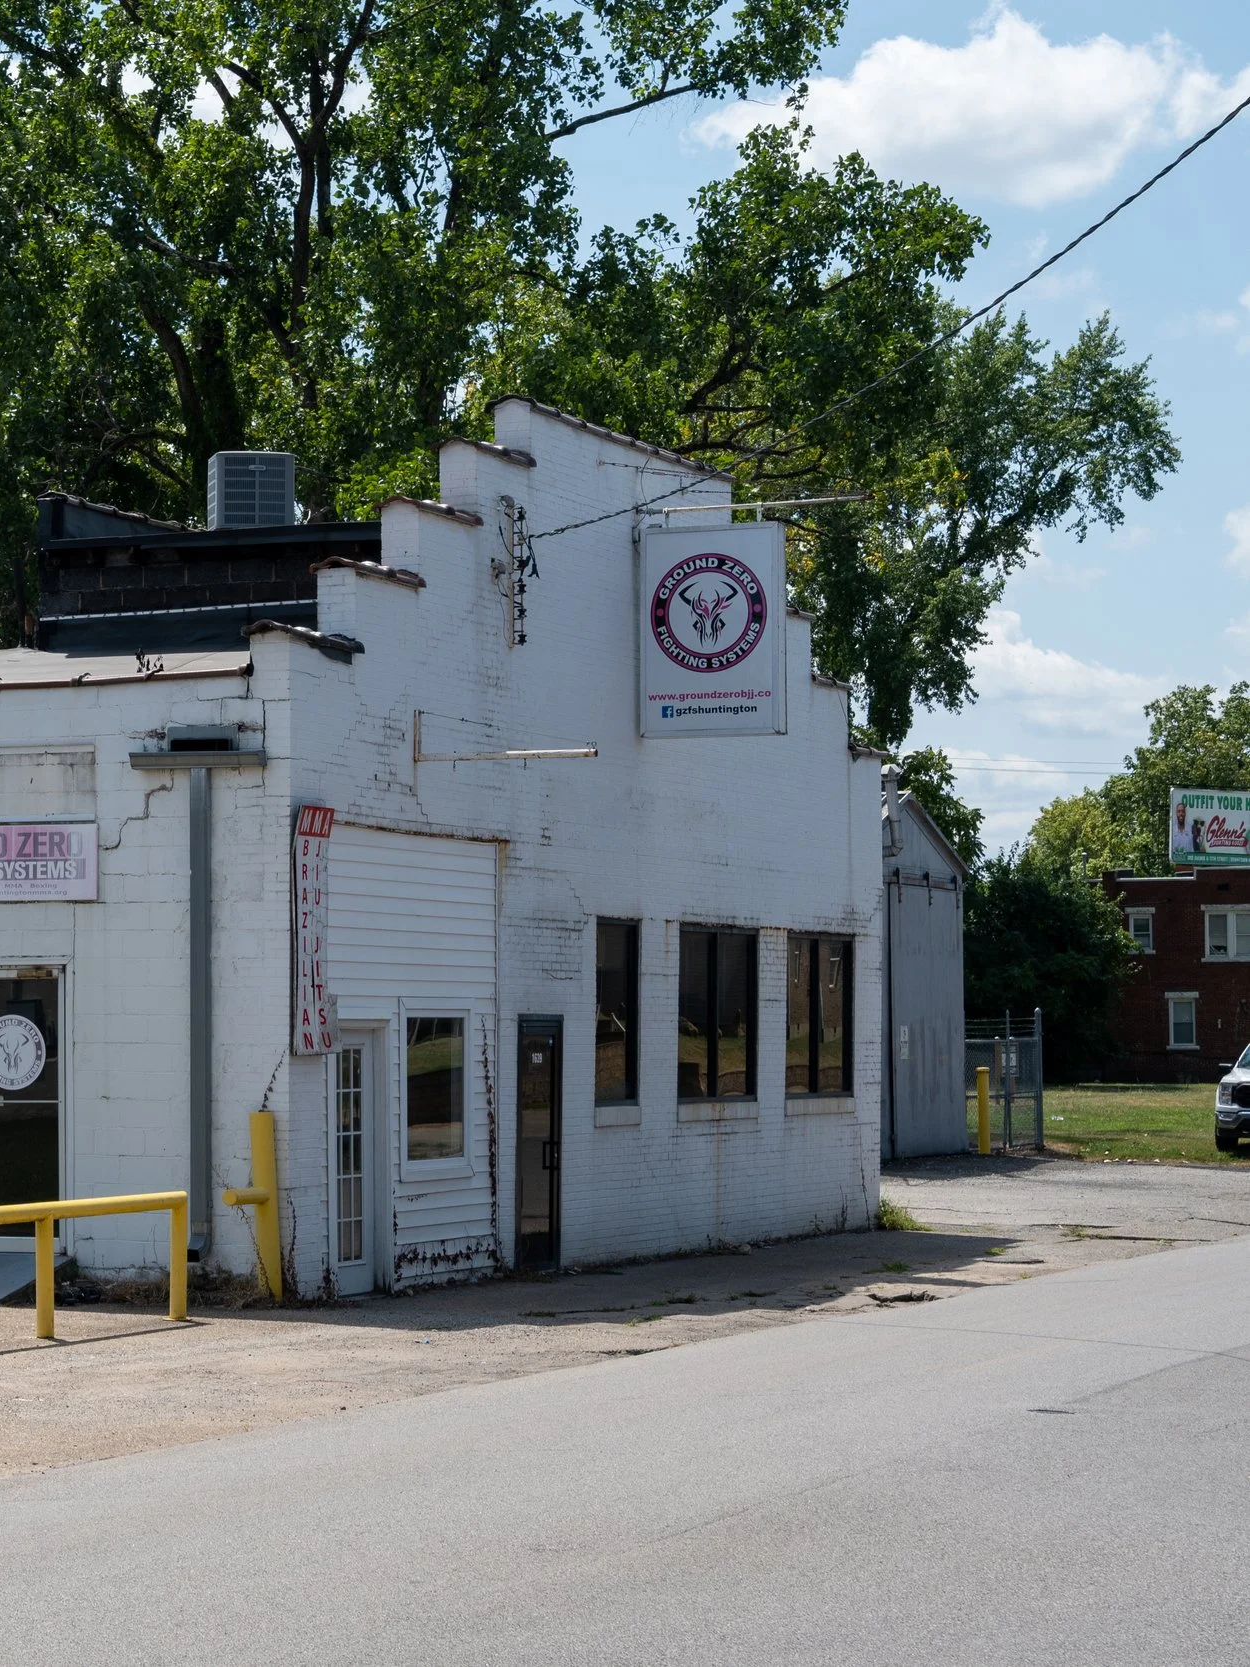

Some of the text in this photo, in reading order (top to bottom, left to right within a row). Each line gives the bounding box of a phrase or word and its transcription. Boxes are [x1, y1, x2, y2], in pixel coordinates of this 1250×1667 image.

[659, 558, 758, 599] GROUND ZERO
[657, 622, 760, 668] FIGHTING SYSTEMS
[648, 689, 771, 702] www.groundzerobjj.co
[675, 704, 757, 717] gzfshuntington
[1182, 794, 1215, 809] OUTFIT
[1217, 795, 1243, 811] YOUR
[301, 807, 331, 835] MMA
[1206, 815, 1246, 842] Glenn's
[16, 830, 83, 858] ZERO
[30, 882, 58, 890] Boxing
[302, 839, 314, 1050] BRAZILIAN
[315, 935, 332, 1049] JITSU
[20, 1021, 40, 1043] ZERO
[14, 1060, 40, 1085] SYSTEMS
